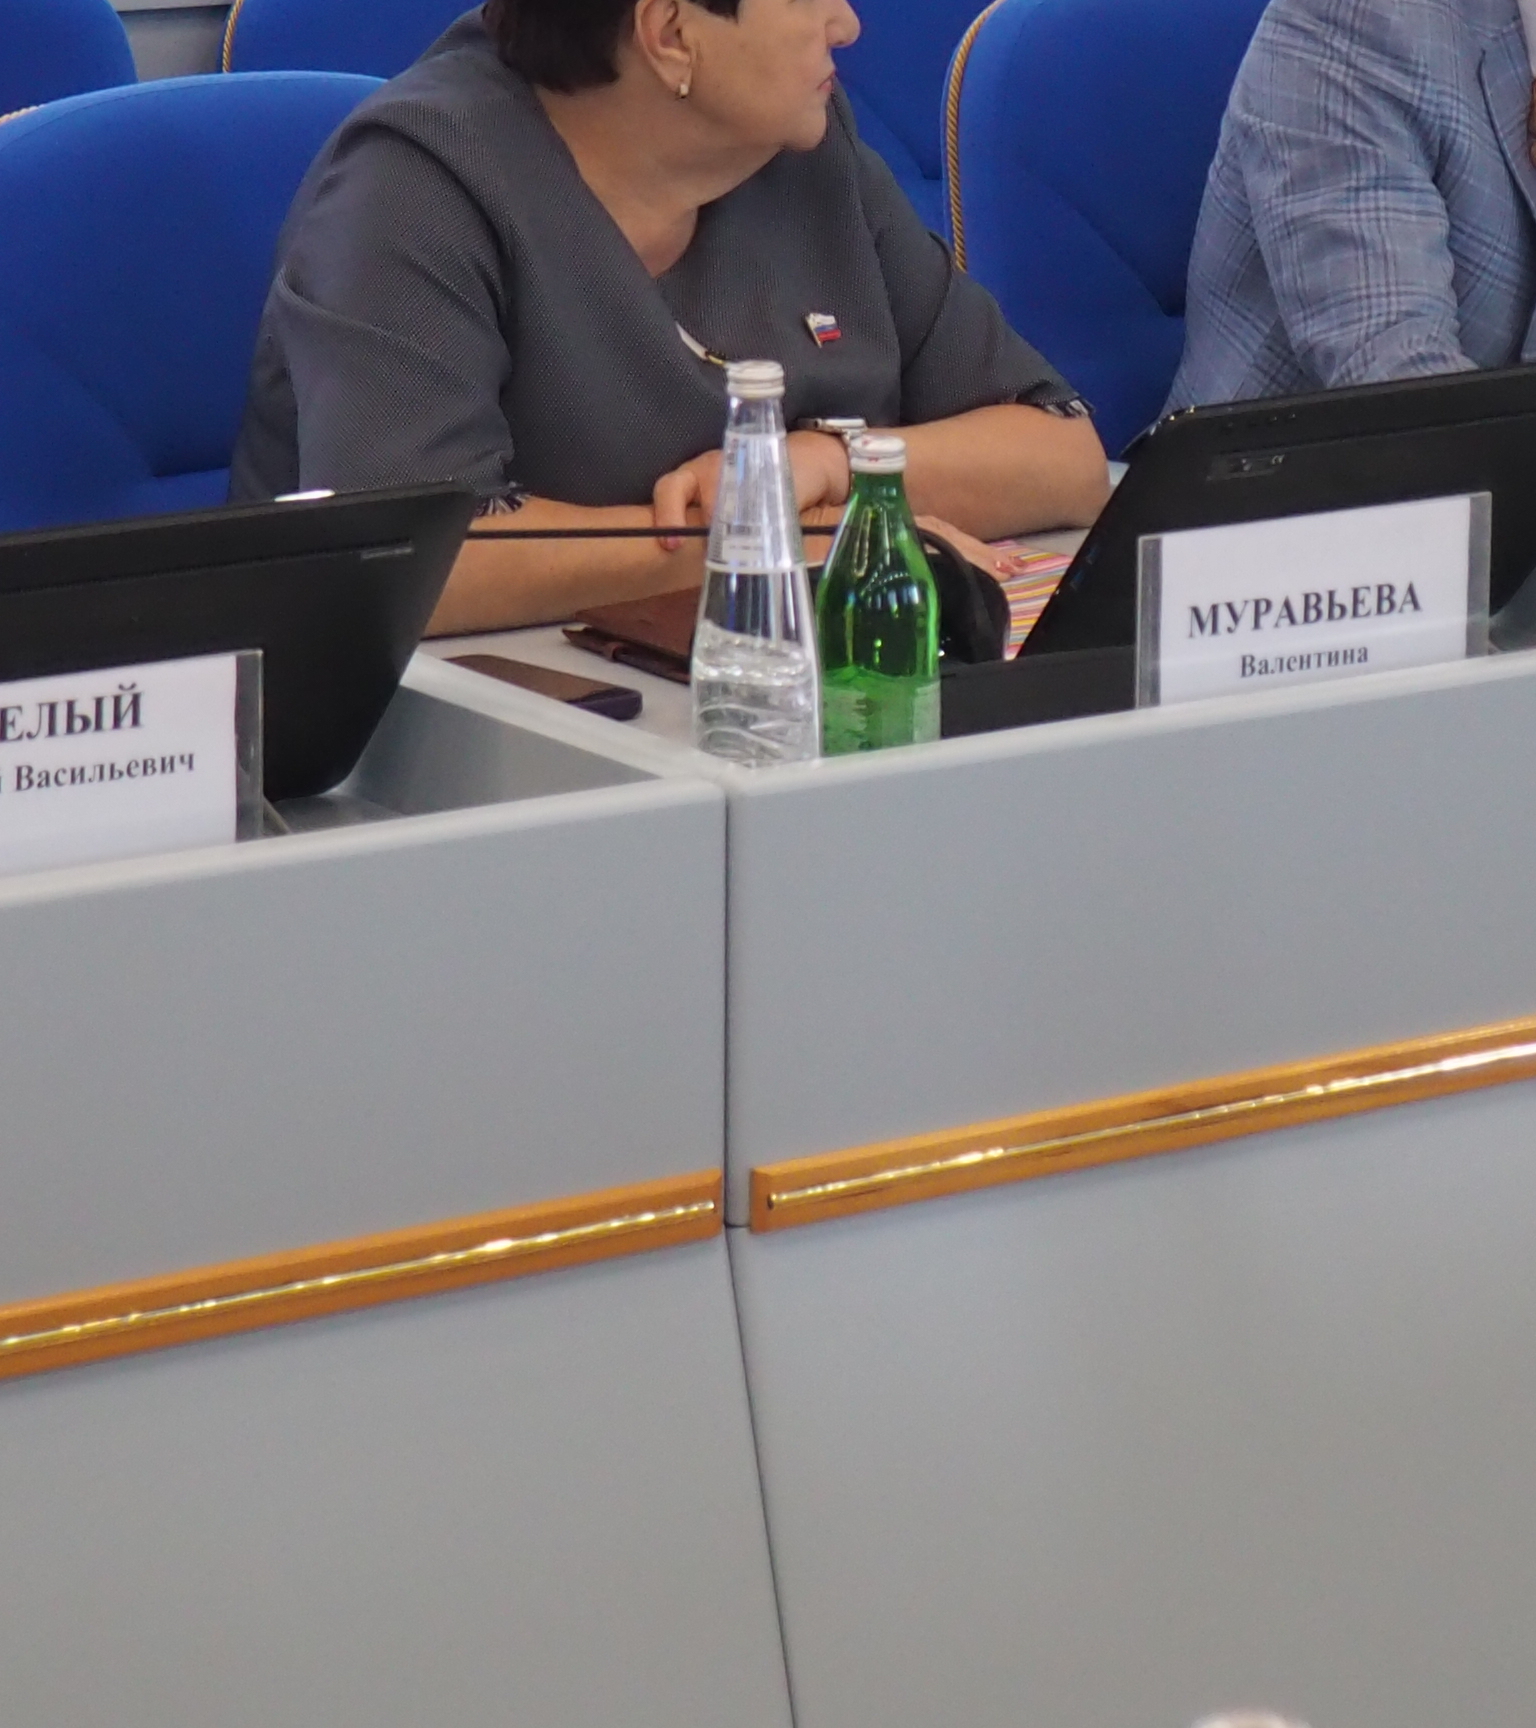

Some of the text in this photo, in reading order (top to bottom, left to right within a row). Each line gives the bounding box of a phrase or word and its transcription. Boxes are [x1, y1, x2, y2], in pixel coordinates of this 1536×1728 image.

[1188, 581, 1423, 638] МУРАВЬЕВА
[1240, 646, 1369, 679] Валентина
[14, 752, 195, 793] Васильевич
